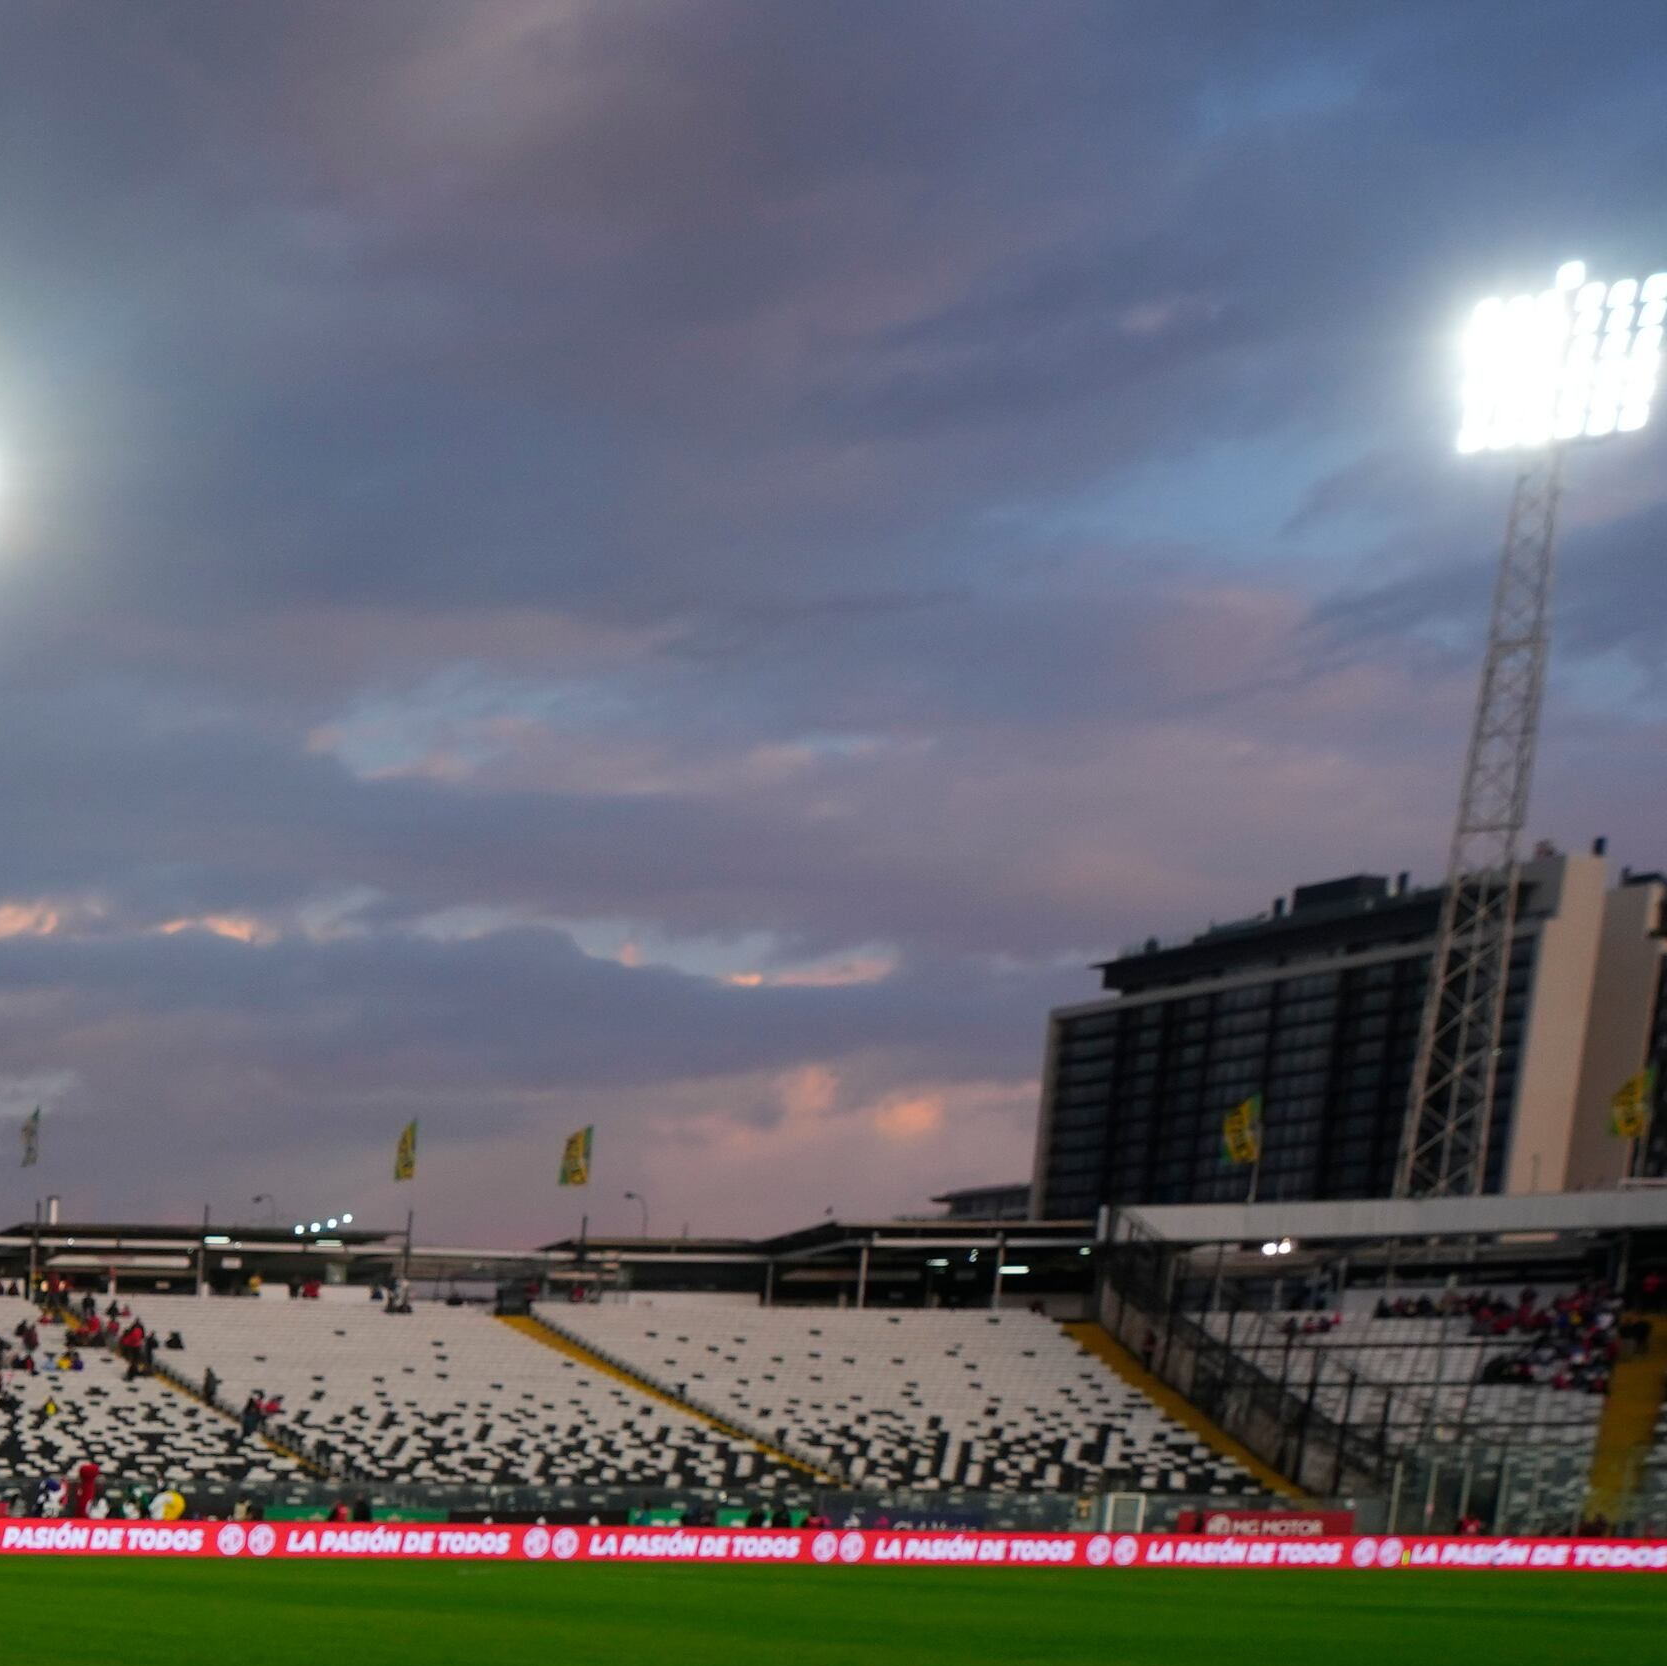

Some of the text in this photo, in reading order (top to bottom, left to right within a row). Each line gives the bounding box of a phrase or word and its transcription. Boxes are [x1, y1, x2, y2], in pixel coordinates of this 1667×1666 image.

[2, 1522, 90, 1549] PASIÓN
[90, 1528, 125, 1549] DE
[127, 1528, 204, 1551] TODOS
[287, 1526, 511, 1554] LA PASIÓN DE TODOS
[589, 1535, 617, 1555] LA
[620, 1531, 699, 1556] PASIÓN
[699, 1536, 730, 1556] DE
[732, 1536, 801, 1558] TODOS
[874, 1539, 901, 1559] LA
[903, 1534, 978, 1560] PASIÓN
[977, 1540, 1006, 1560] DE
[1010, 1540, 1076, 1561] TODOS
